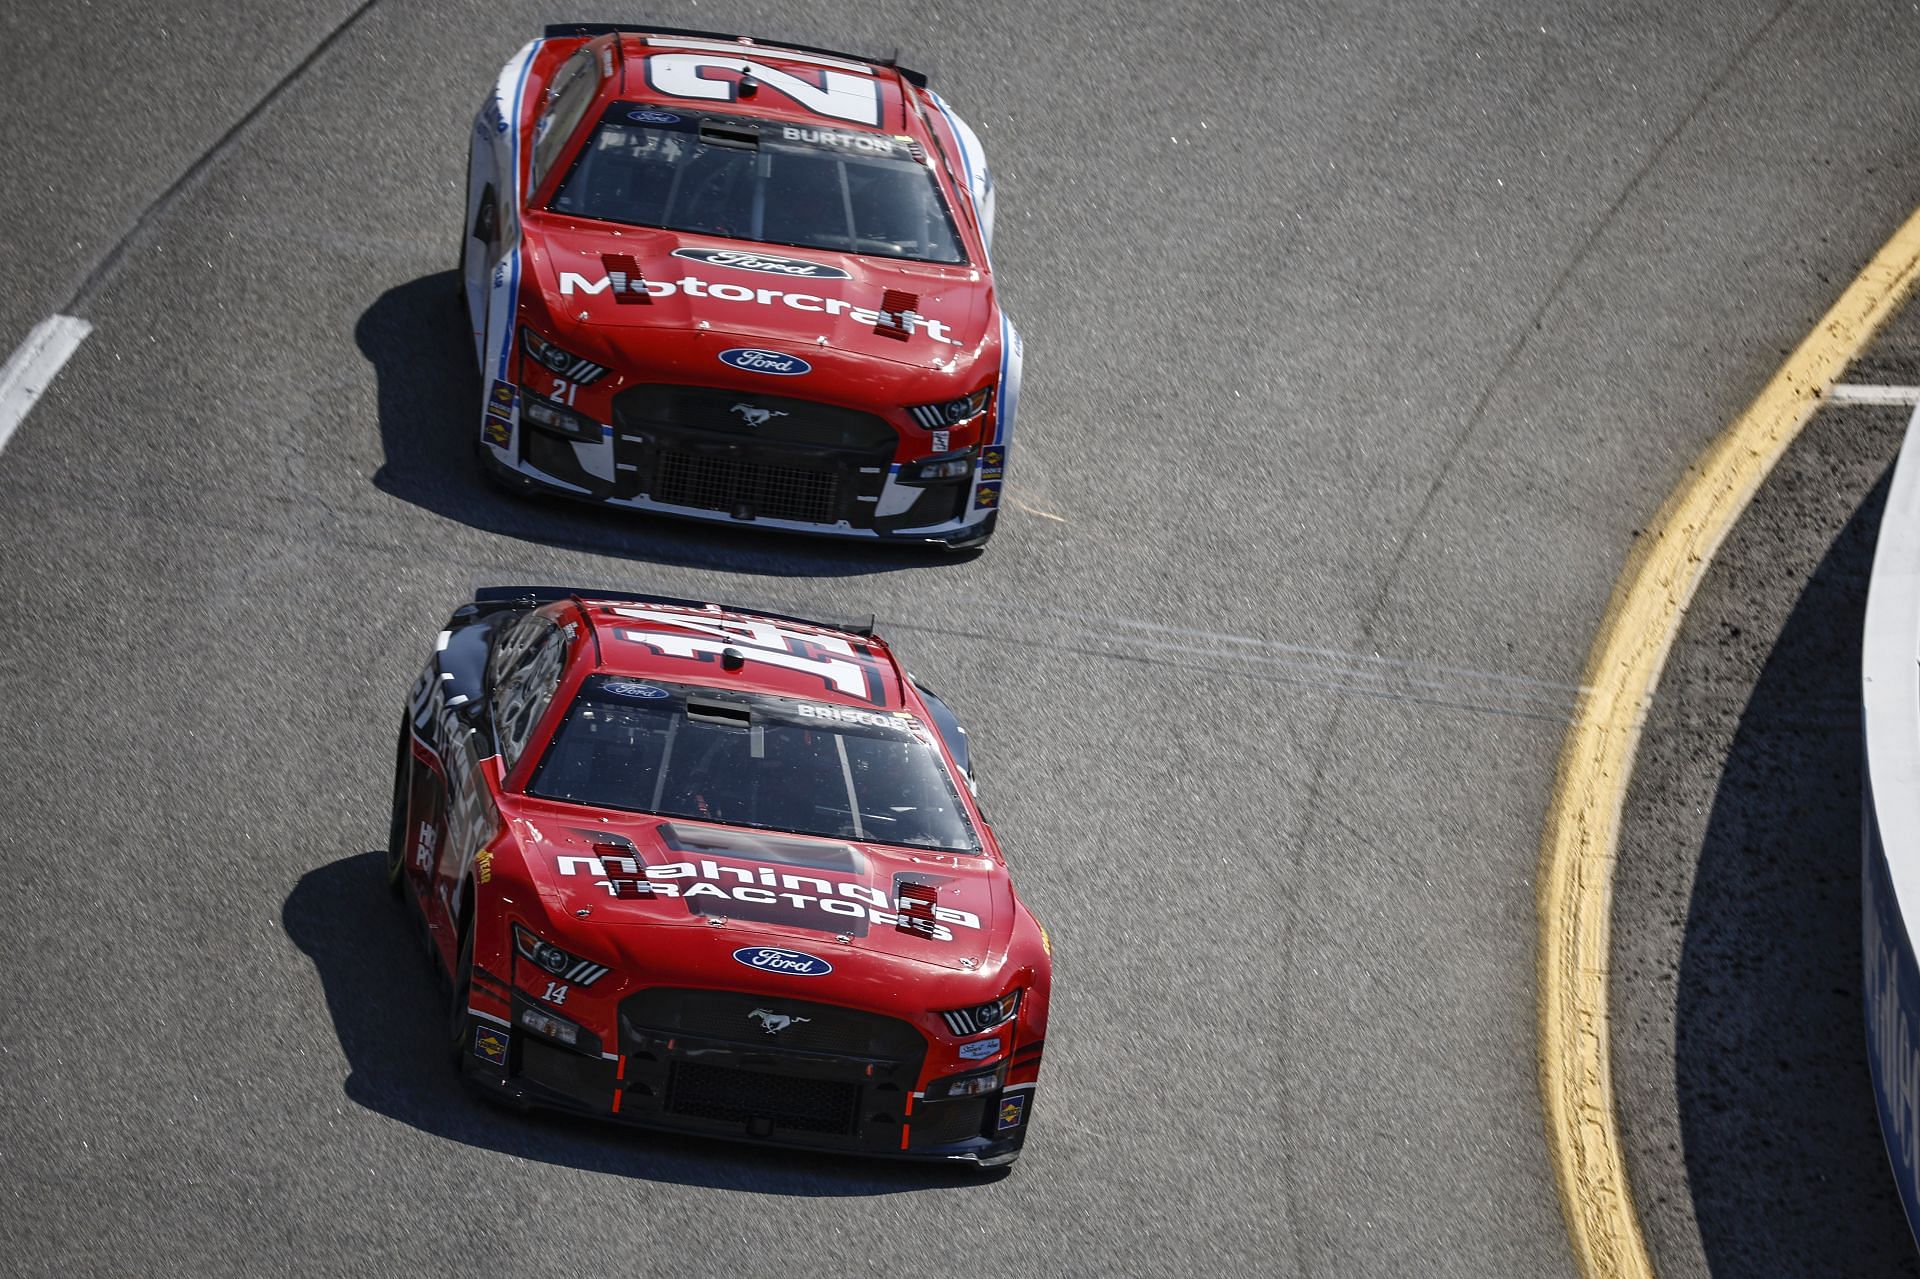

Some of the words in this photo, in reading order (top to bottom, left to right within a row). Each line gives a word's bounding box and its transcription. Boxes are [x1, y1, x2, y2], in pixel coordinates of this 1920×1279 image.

[783, 126, 893, 152] BURTON
[716, 249, 817, 276] Ford
[560, 271, 954, 341] Motorcraft
[735, 351, 796, 373] Ford
[550, 379, 577, 406] 21
[797, 704, 909, 730] BRISCOE
[557, 855, 980, 929] mahindra
[595, 880, 954, 941] TRACTORS
[752, 949, 815, 974] Ford
[541, 981, 568, 1005] 14
